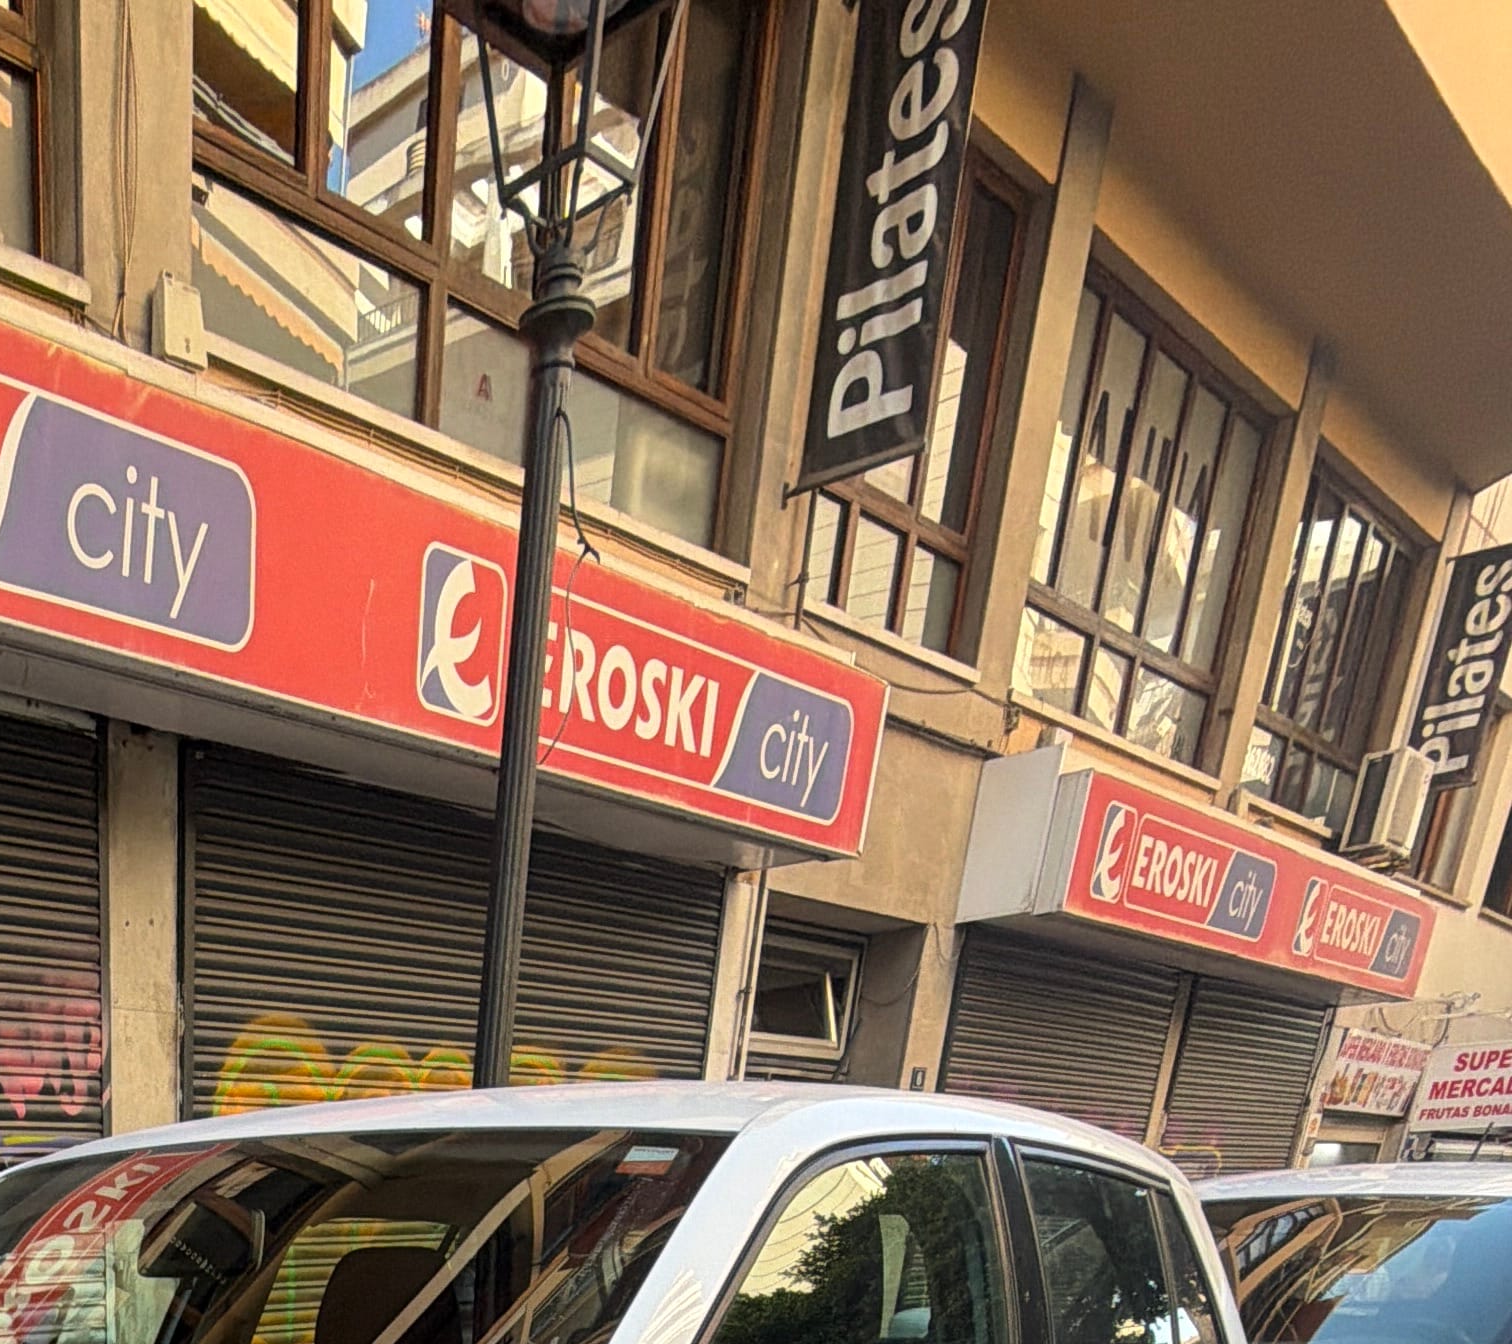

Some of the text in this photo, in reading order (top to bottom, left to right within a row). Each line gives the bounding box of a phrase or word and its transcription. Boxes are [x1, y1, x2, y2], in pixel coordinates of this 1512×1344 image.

[827, 0, 971, 440] Pilates
[65, 464, 209, 619] city
[1419, 558, 1512, 775] Pilates
[759, 709, 830, 808] city
[1131, 833, 1263, 932] EROSKI city
[1319, 900, 1412, 975] EROSKI city
[1453, 1049, 1512, 1073] SUPE
[1418, 1105, 1471, 1121] FRUTAS
